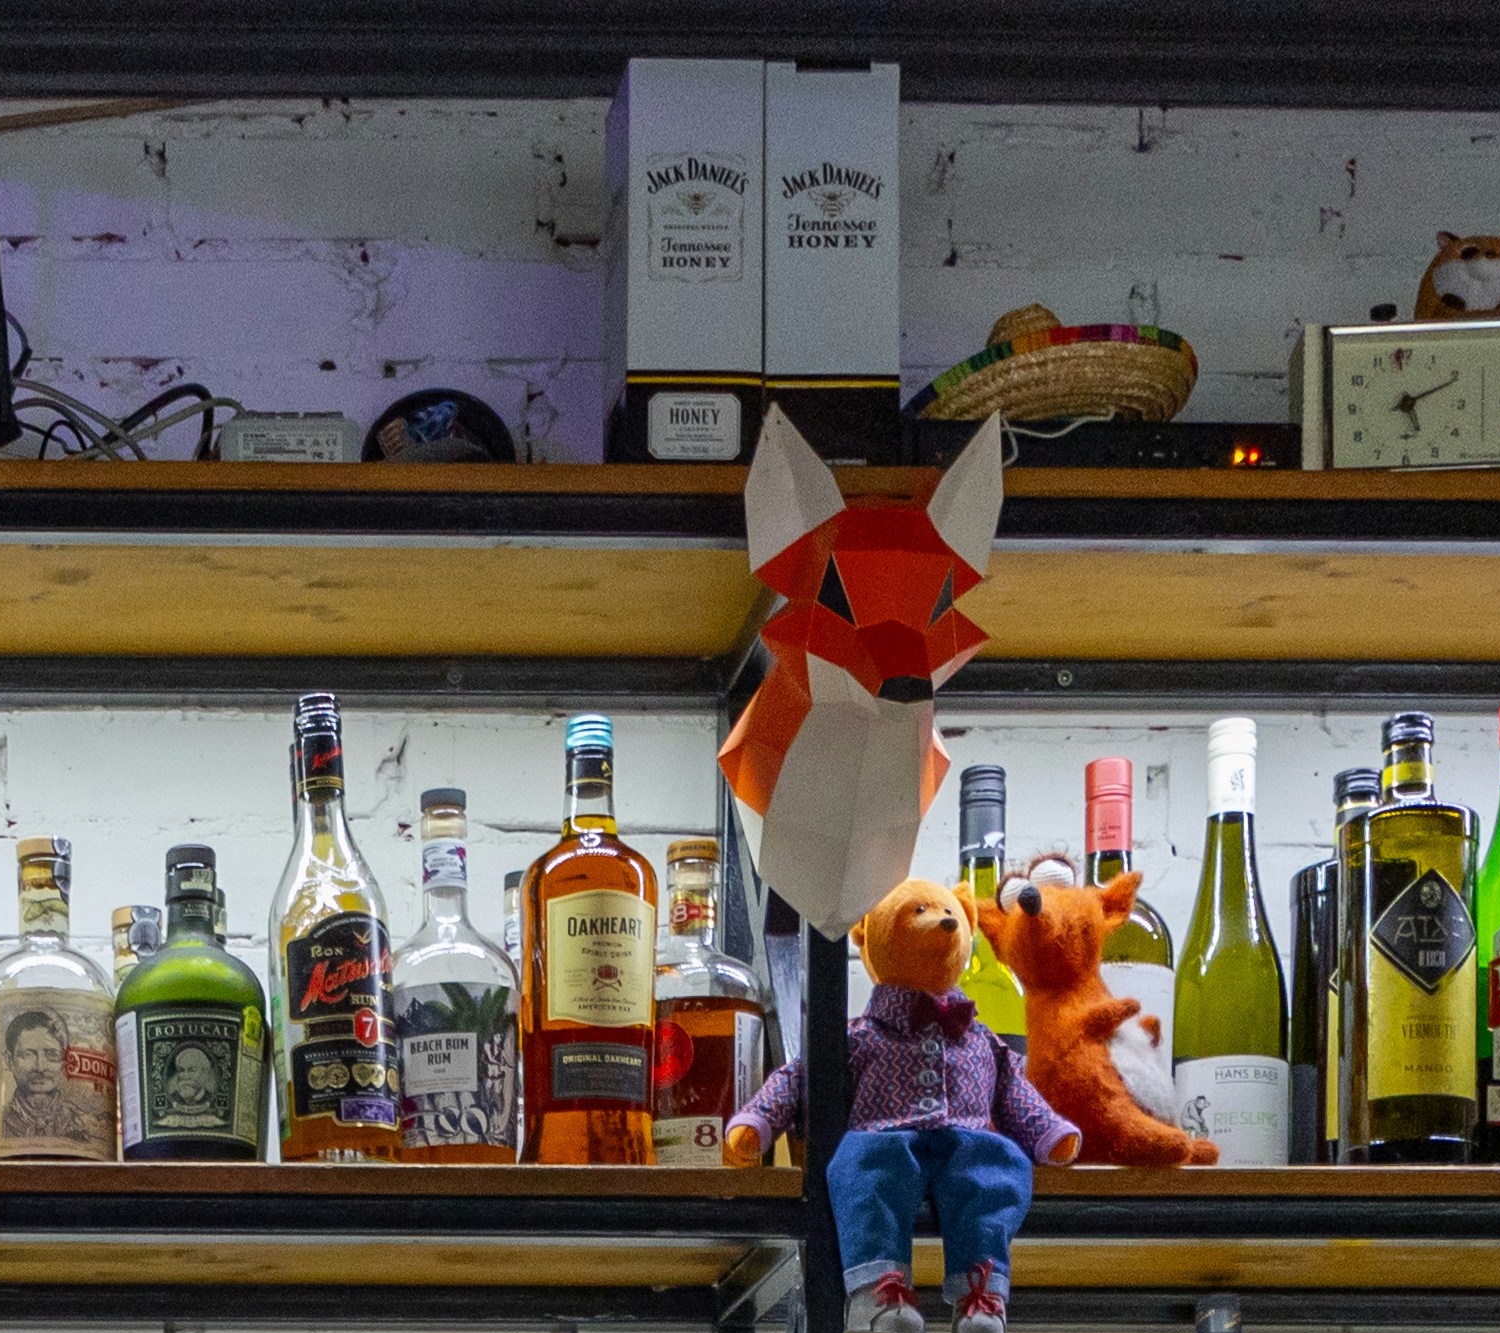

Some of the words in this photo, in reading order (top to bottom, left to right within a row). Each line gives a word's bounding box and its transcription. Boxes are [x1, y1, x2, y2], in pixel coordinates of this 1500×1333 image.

[647, 159, 688, 194] JACK
[688, 157, 750, 196] DANIEL'S
[782, 164, 824, 199] JACK
[824, 162, 885, 201] DANIEL'S
[786, 215, 878, 234] Tennessee
[788, 234, 876, 249] HONEY
[661, 255, 731, 269] HONEY
[669, 408, 721, 426] HONEY
[567, 919, 643, 938] OAKHEART
[309, 947, 344, 958] RON
[153, 1025, 232, 1038] BOTUCAL
[362, 1015, 376, 1039] 7
[410, 1041, 443, 1055] BEACH
[446, 1039, 470, 1052] BUM
[427, 1053, 452, 1066] RUM
[1405, 1065, 1453, 1074] MANGO
[694, 1123, 718, 1148] 8
